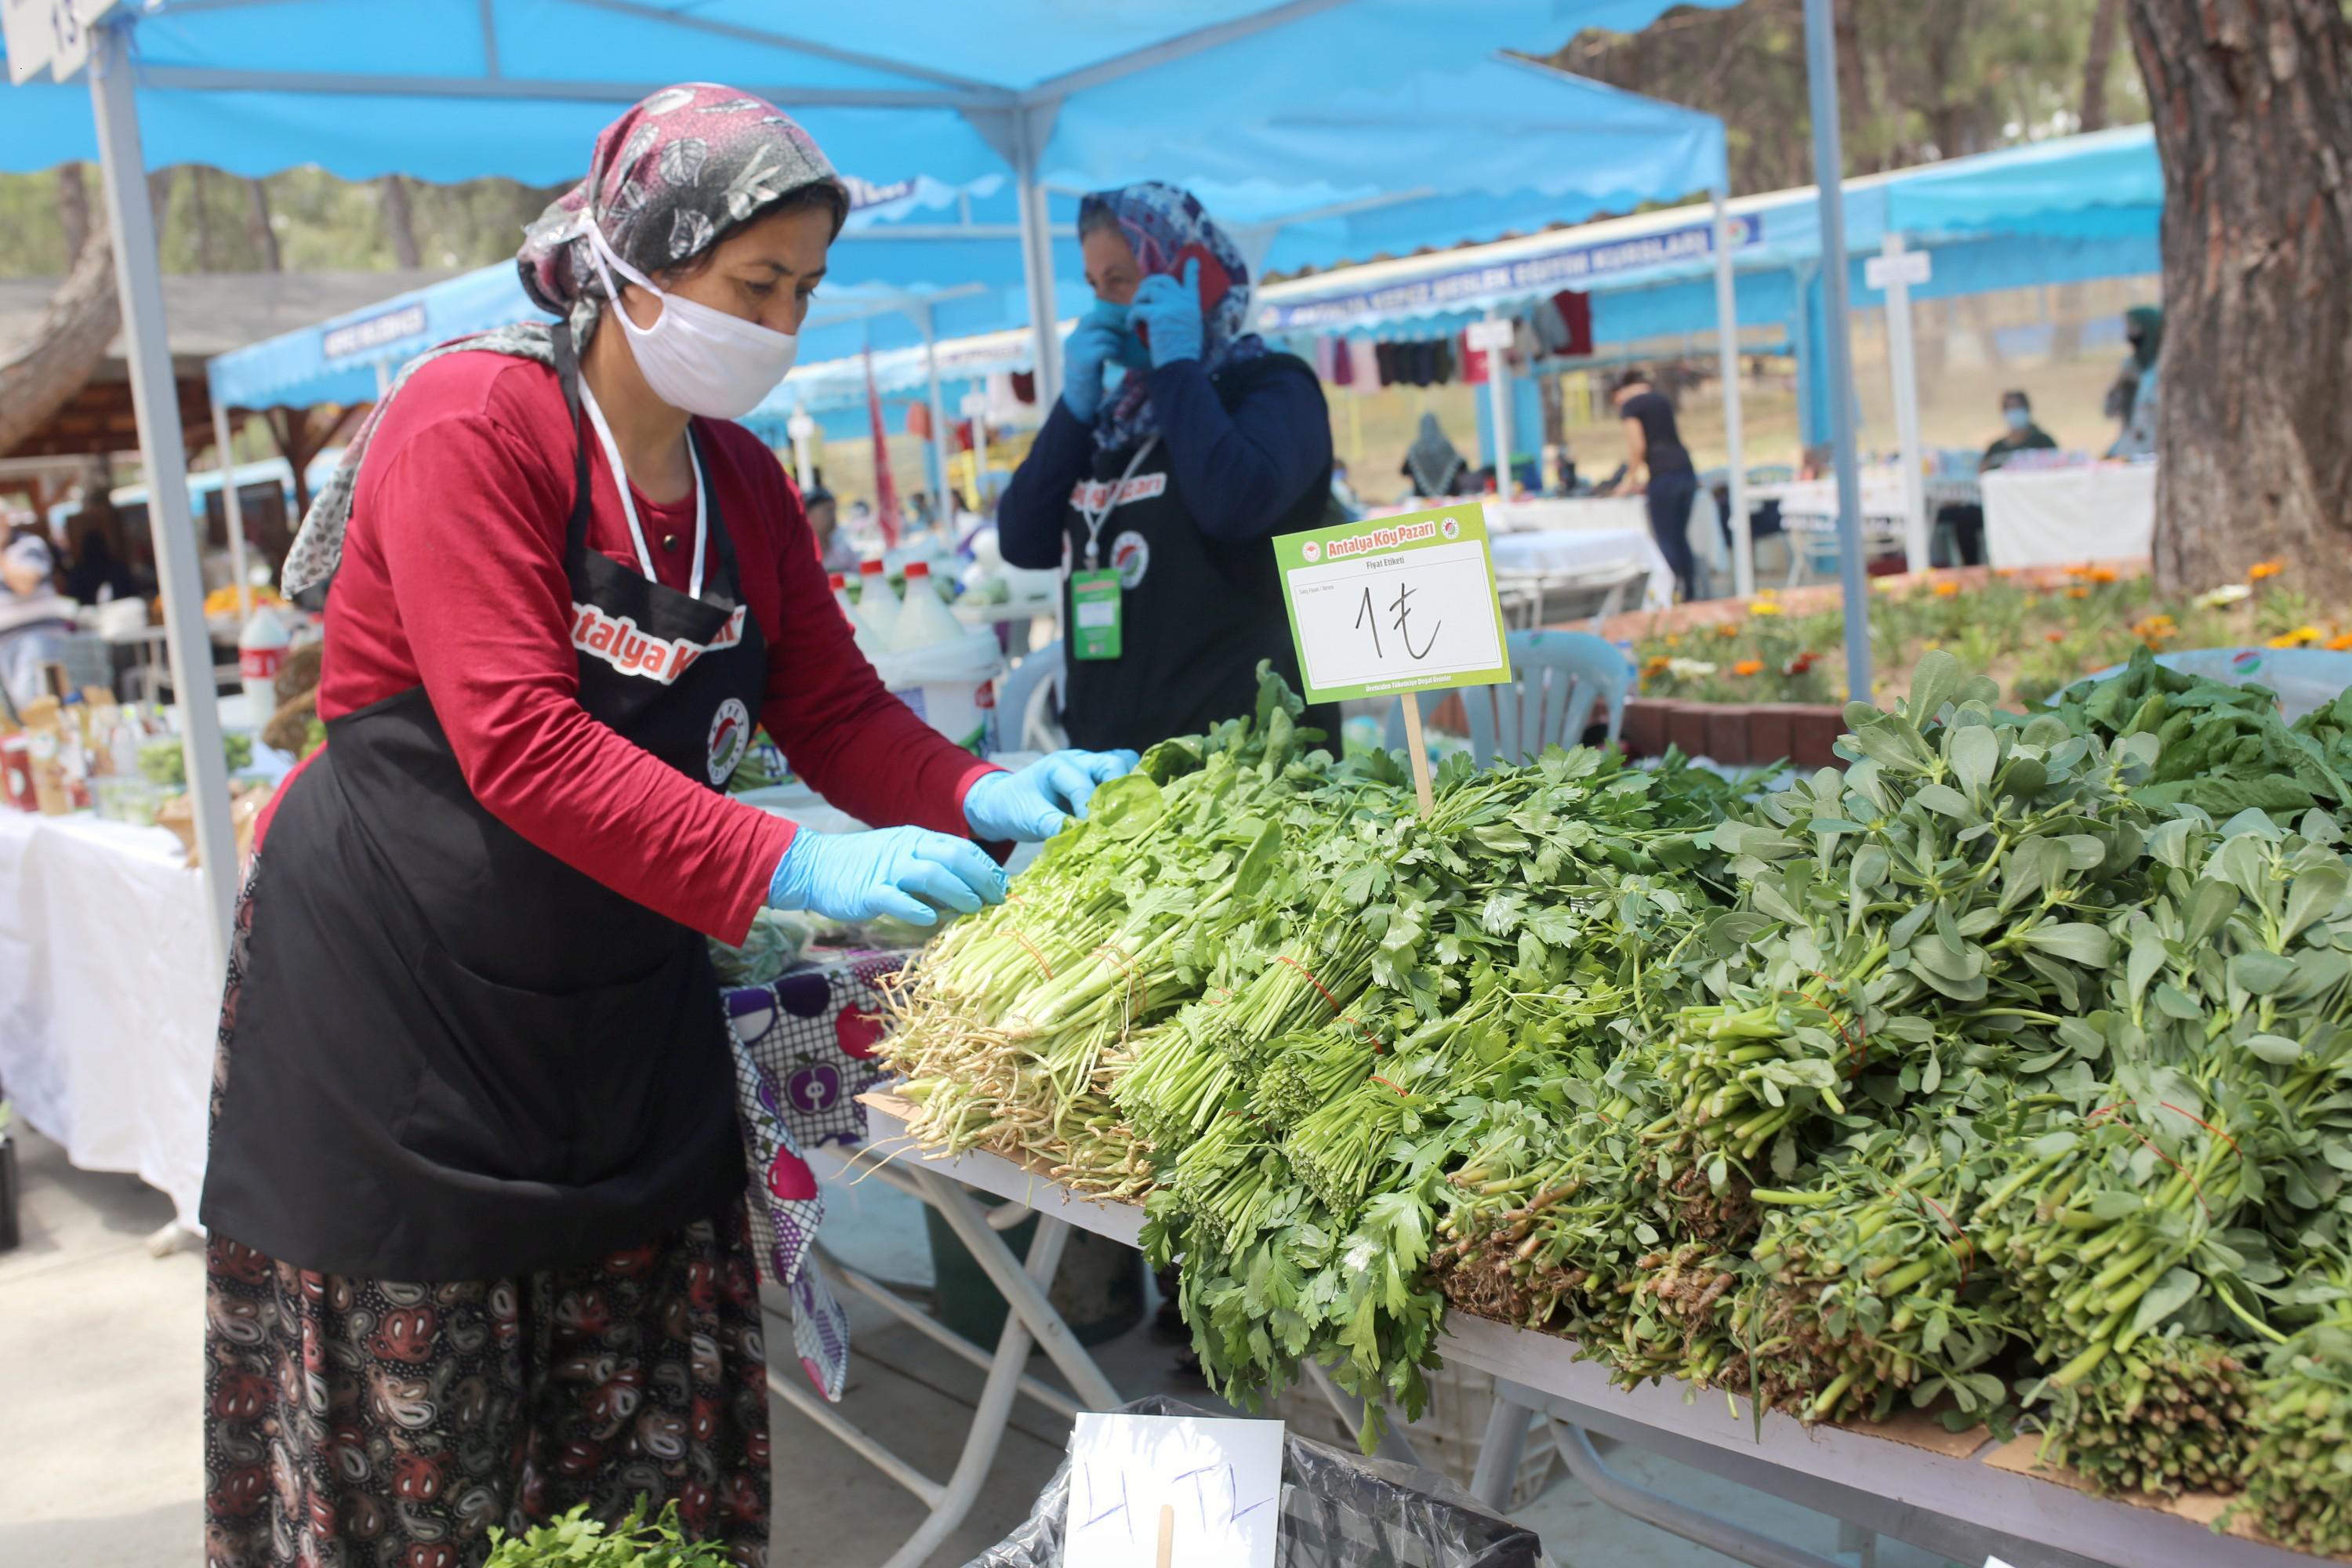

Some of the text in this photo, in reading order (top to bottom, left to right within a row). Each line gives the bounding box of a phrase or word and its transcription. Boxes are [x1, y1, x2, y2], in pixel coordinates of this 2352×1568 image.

[1328, 536, 1374, 557] Antalya
[1374, 530, 1398, 546] Köy
[1398, 523, 1434, 541] Pazarı
[1367, 556, 1405, 570] Fiyat Etiketi
[572, 608, 666, 673] talya
[1171, 1463, 1274, 1534] TL
